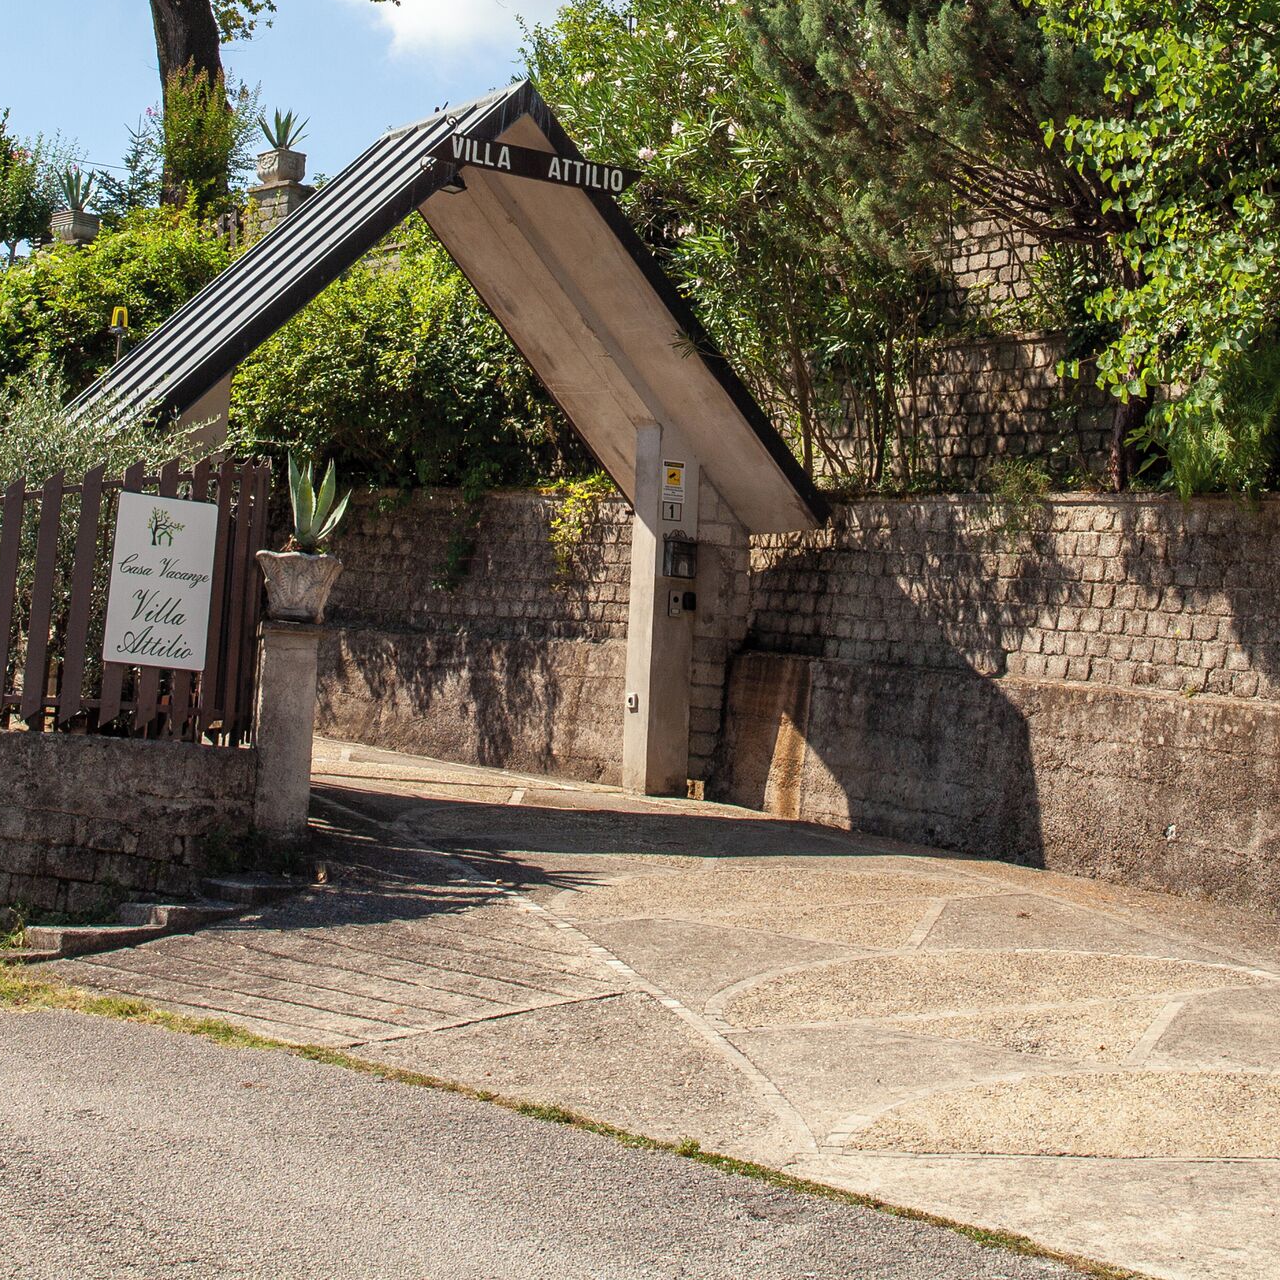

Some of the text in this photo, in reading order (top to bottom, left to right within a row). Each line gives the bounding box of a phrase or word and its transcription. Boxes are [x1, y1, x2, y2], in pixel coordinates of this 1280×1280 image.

[452, 135, 623, 192] VILLA ATTILIO
[669, 504, 674, 519] 1
[117, 553, 210, 588] Casa Vacanze
[131, 590, 186, 625] Villa
[116, 625, 194, 659] Attilio
